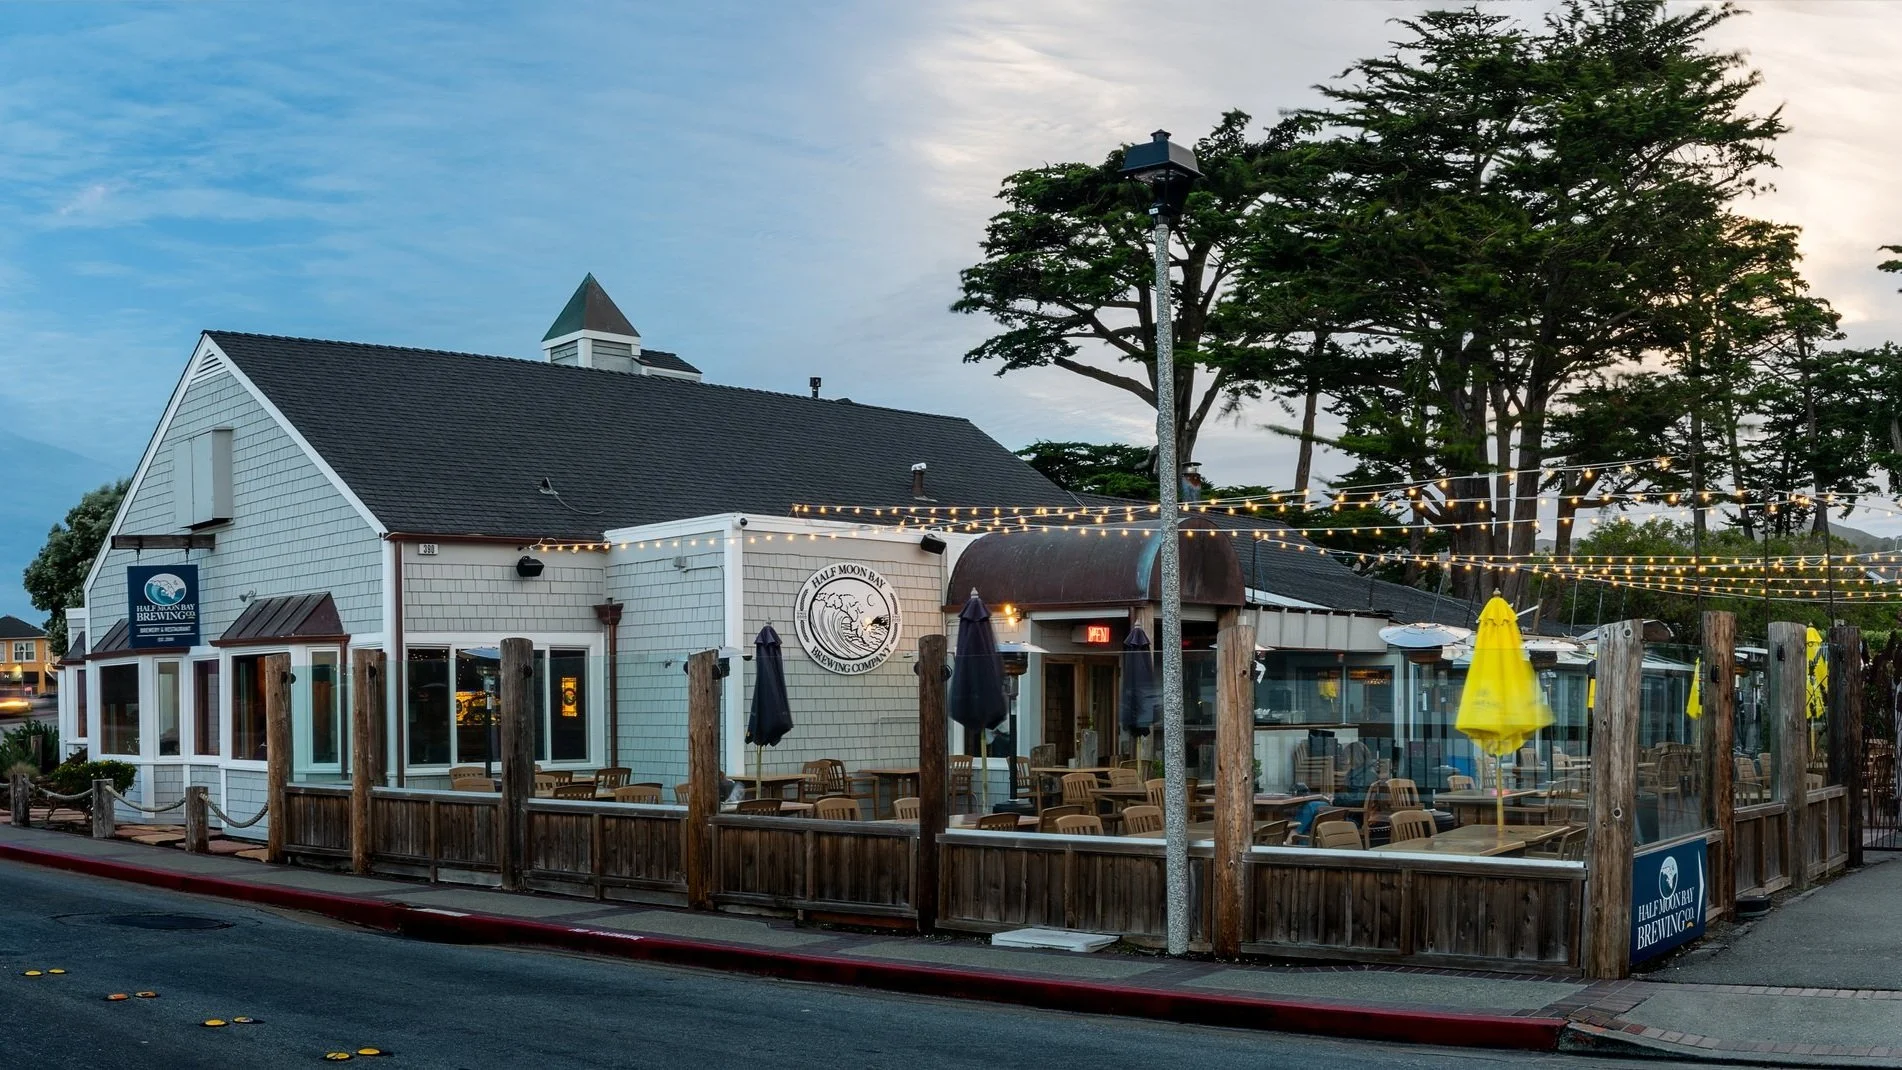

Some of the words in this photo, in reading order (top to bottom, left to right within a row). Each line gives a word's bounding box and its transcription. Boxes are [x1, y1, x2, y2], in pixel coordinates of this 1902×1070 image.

[423, 544, 435, 554] 390
[811, 566, 837, 588] HALF
[838, 564, 867, 577] MOON
[868, 571, 886, 589] BAY
[136, 612, 186, 621] BREWING
[1087, 626, 1110, 642] OPEN
[811, 645, 851, 673] BREWING
[851, 645, 892, 673] COMPANY
[1638, 899, 1659, 923] HALF
[1659, 891, 1681, 915] MOON
[1681, 886, 1695, 906] BAY
[1637, 909, 1685, 951] BREWING
